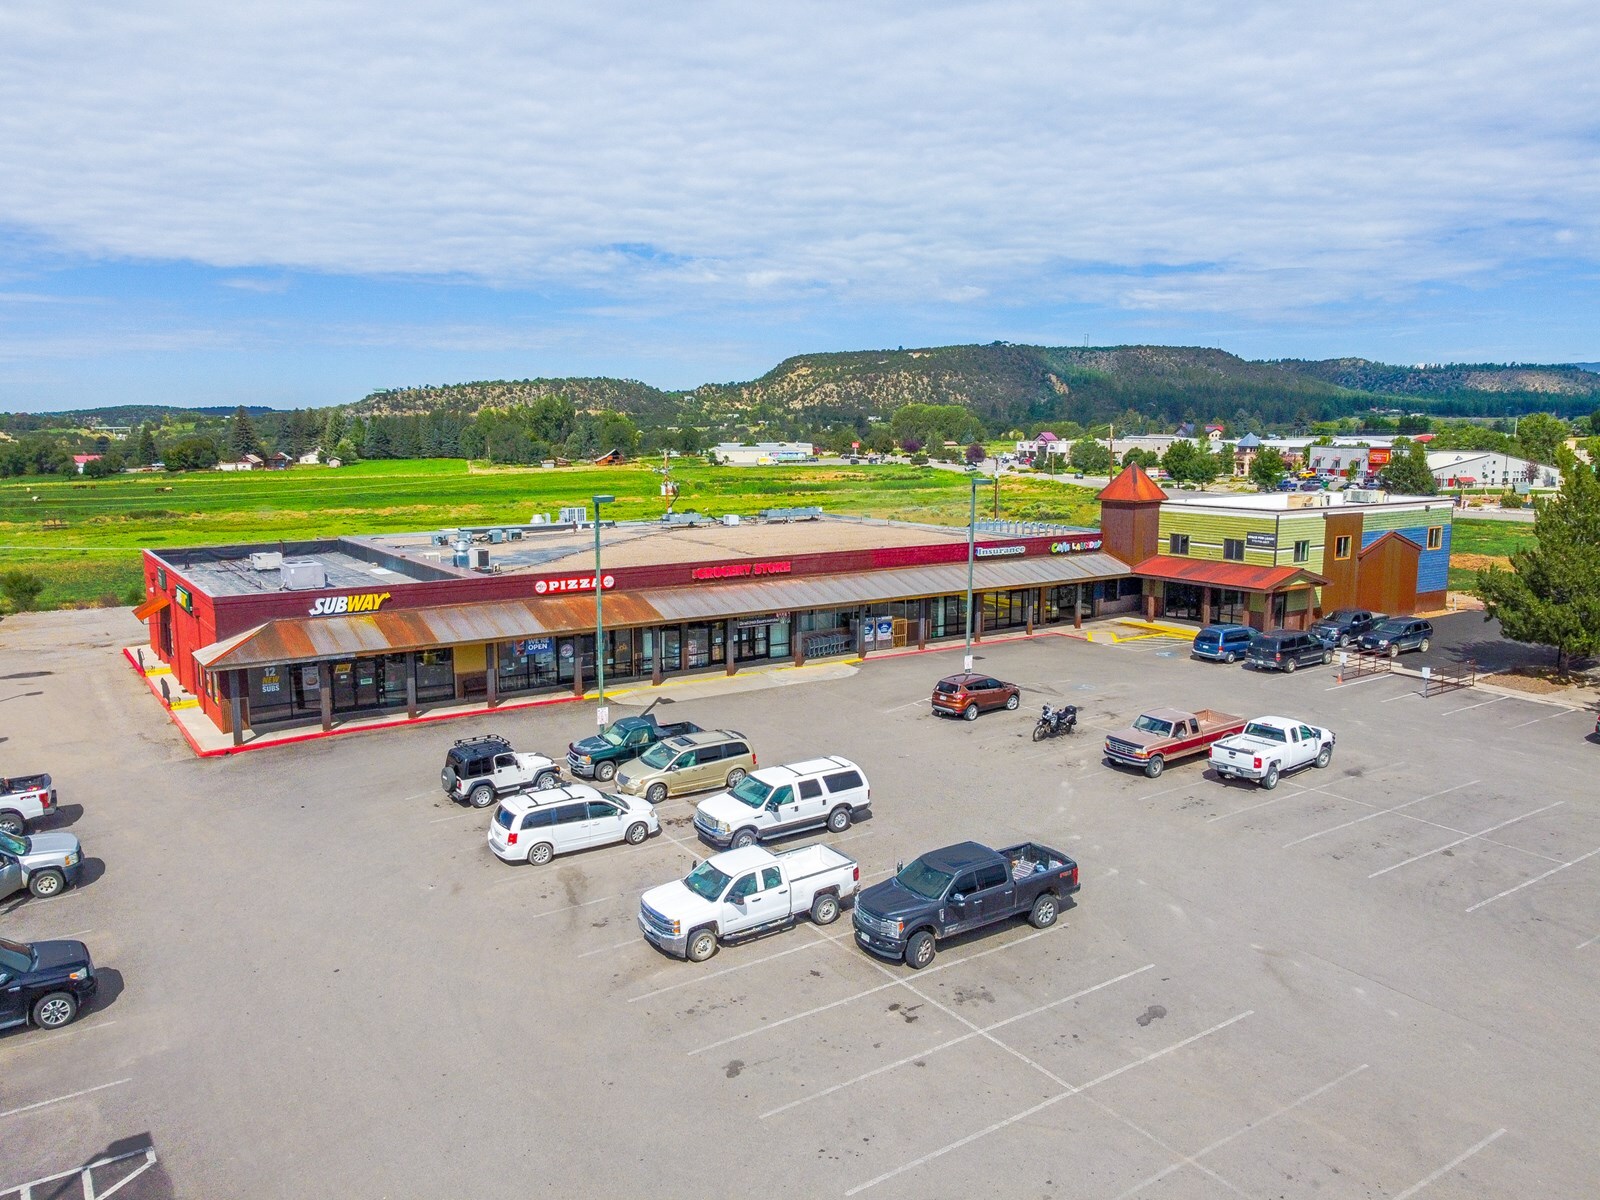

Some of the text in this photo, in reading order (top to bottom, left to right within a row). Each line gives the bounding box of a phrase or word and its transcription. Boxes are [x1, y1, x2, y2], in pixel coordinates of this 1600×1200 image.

[976, 545, 1026, 557] Insurance
[697, 561, 791, 579] GROCERY STORE
[548, 577, 602, 591] PIZZA
[308, 592, 391, 615] SUBWAY
[527, 636, 550, 644] WERE
[527, 643, 548, 651] OPEN
[264, 667, 276, 677] 12
[262, 676, 280, 684] NEW
